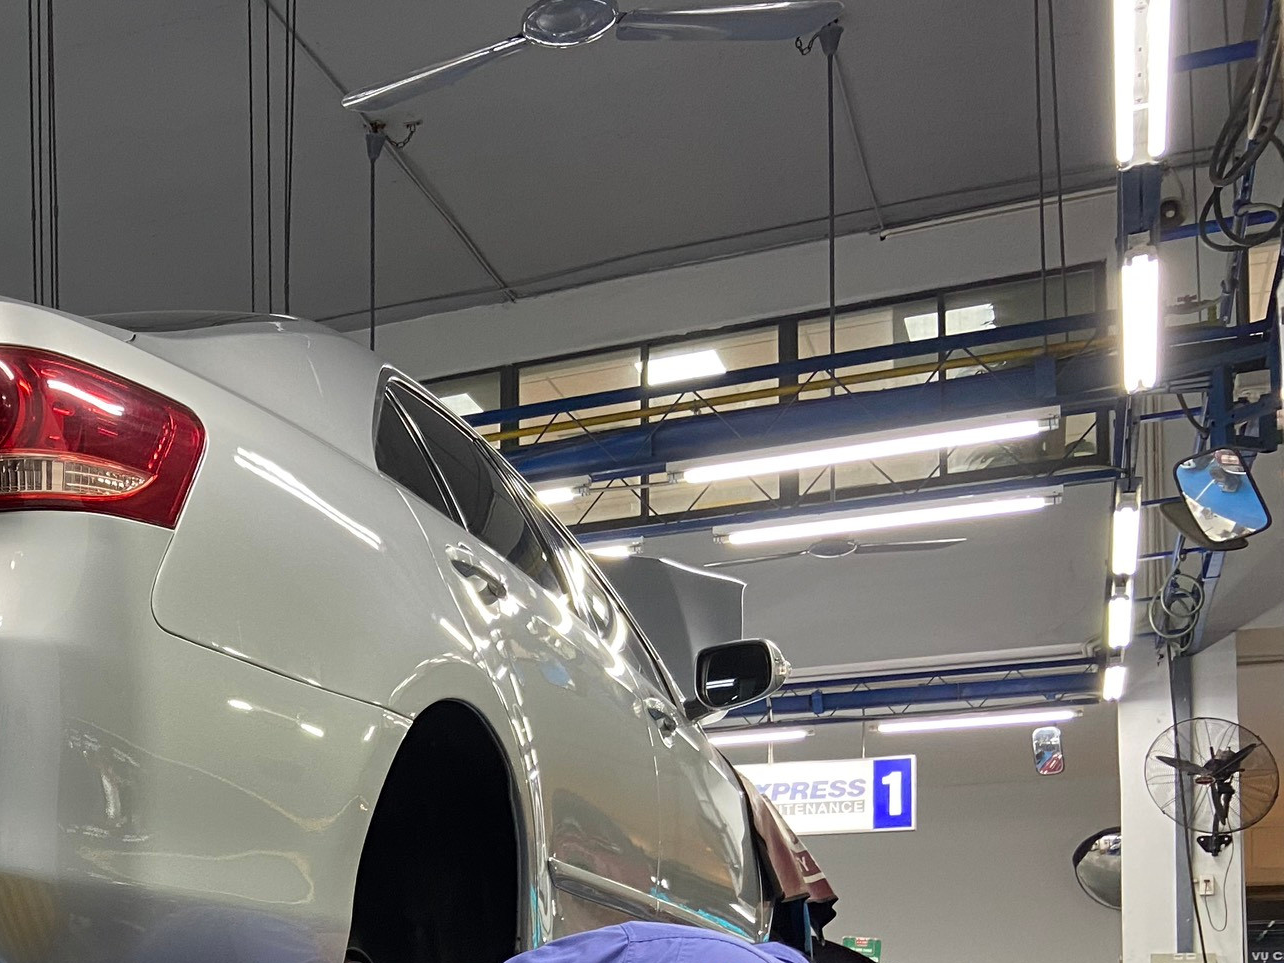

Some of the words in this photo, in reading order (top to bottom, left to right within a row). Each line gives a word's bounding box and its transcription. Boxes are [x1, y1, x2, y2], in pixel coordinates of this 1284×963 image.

[756, 779, 867, 801] XPRESS
[881, 771, 902, 816] 1
[778, 801, 865, 816] TENANCE
[1252, 951, 1269, 963] VỤ
